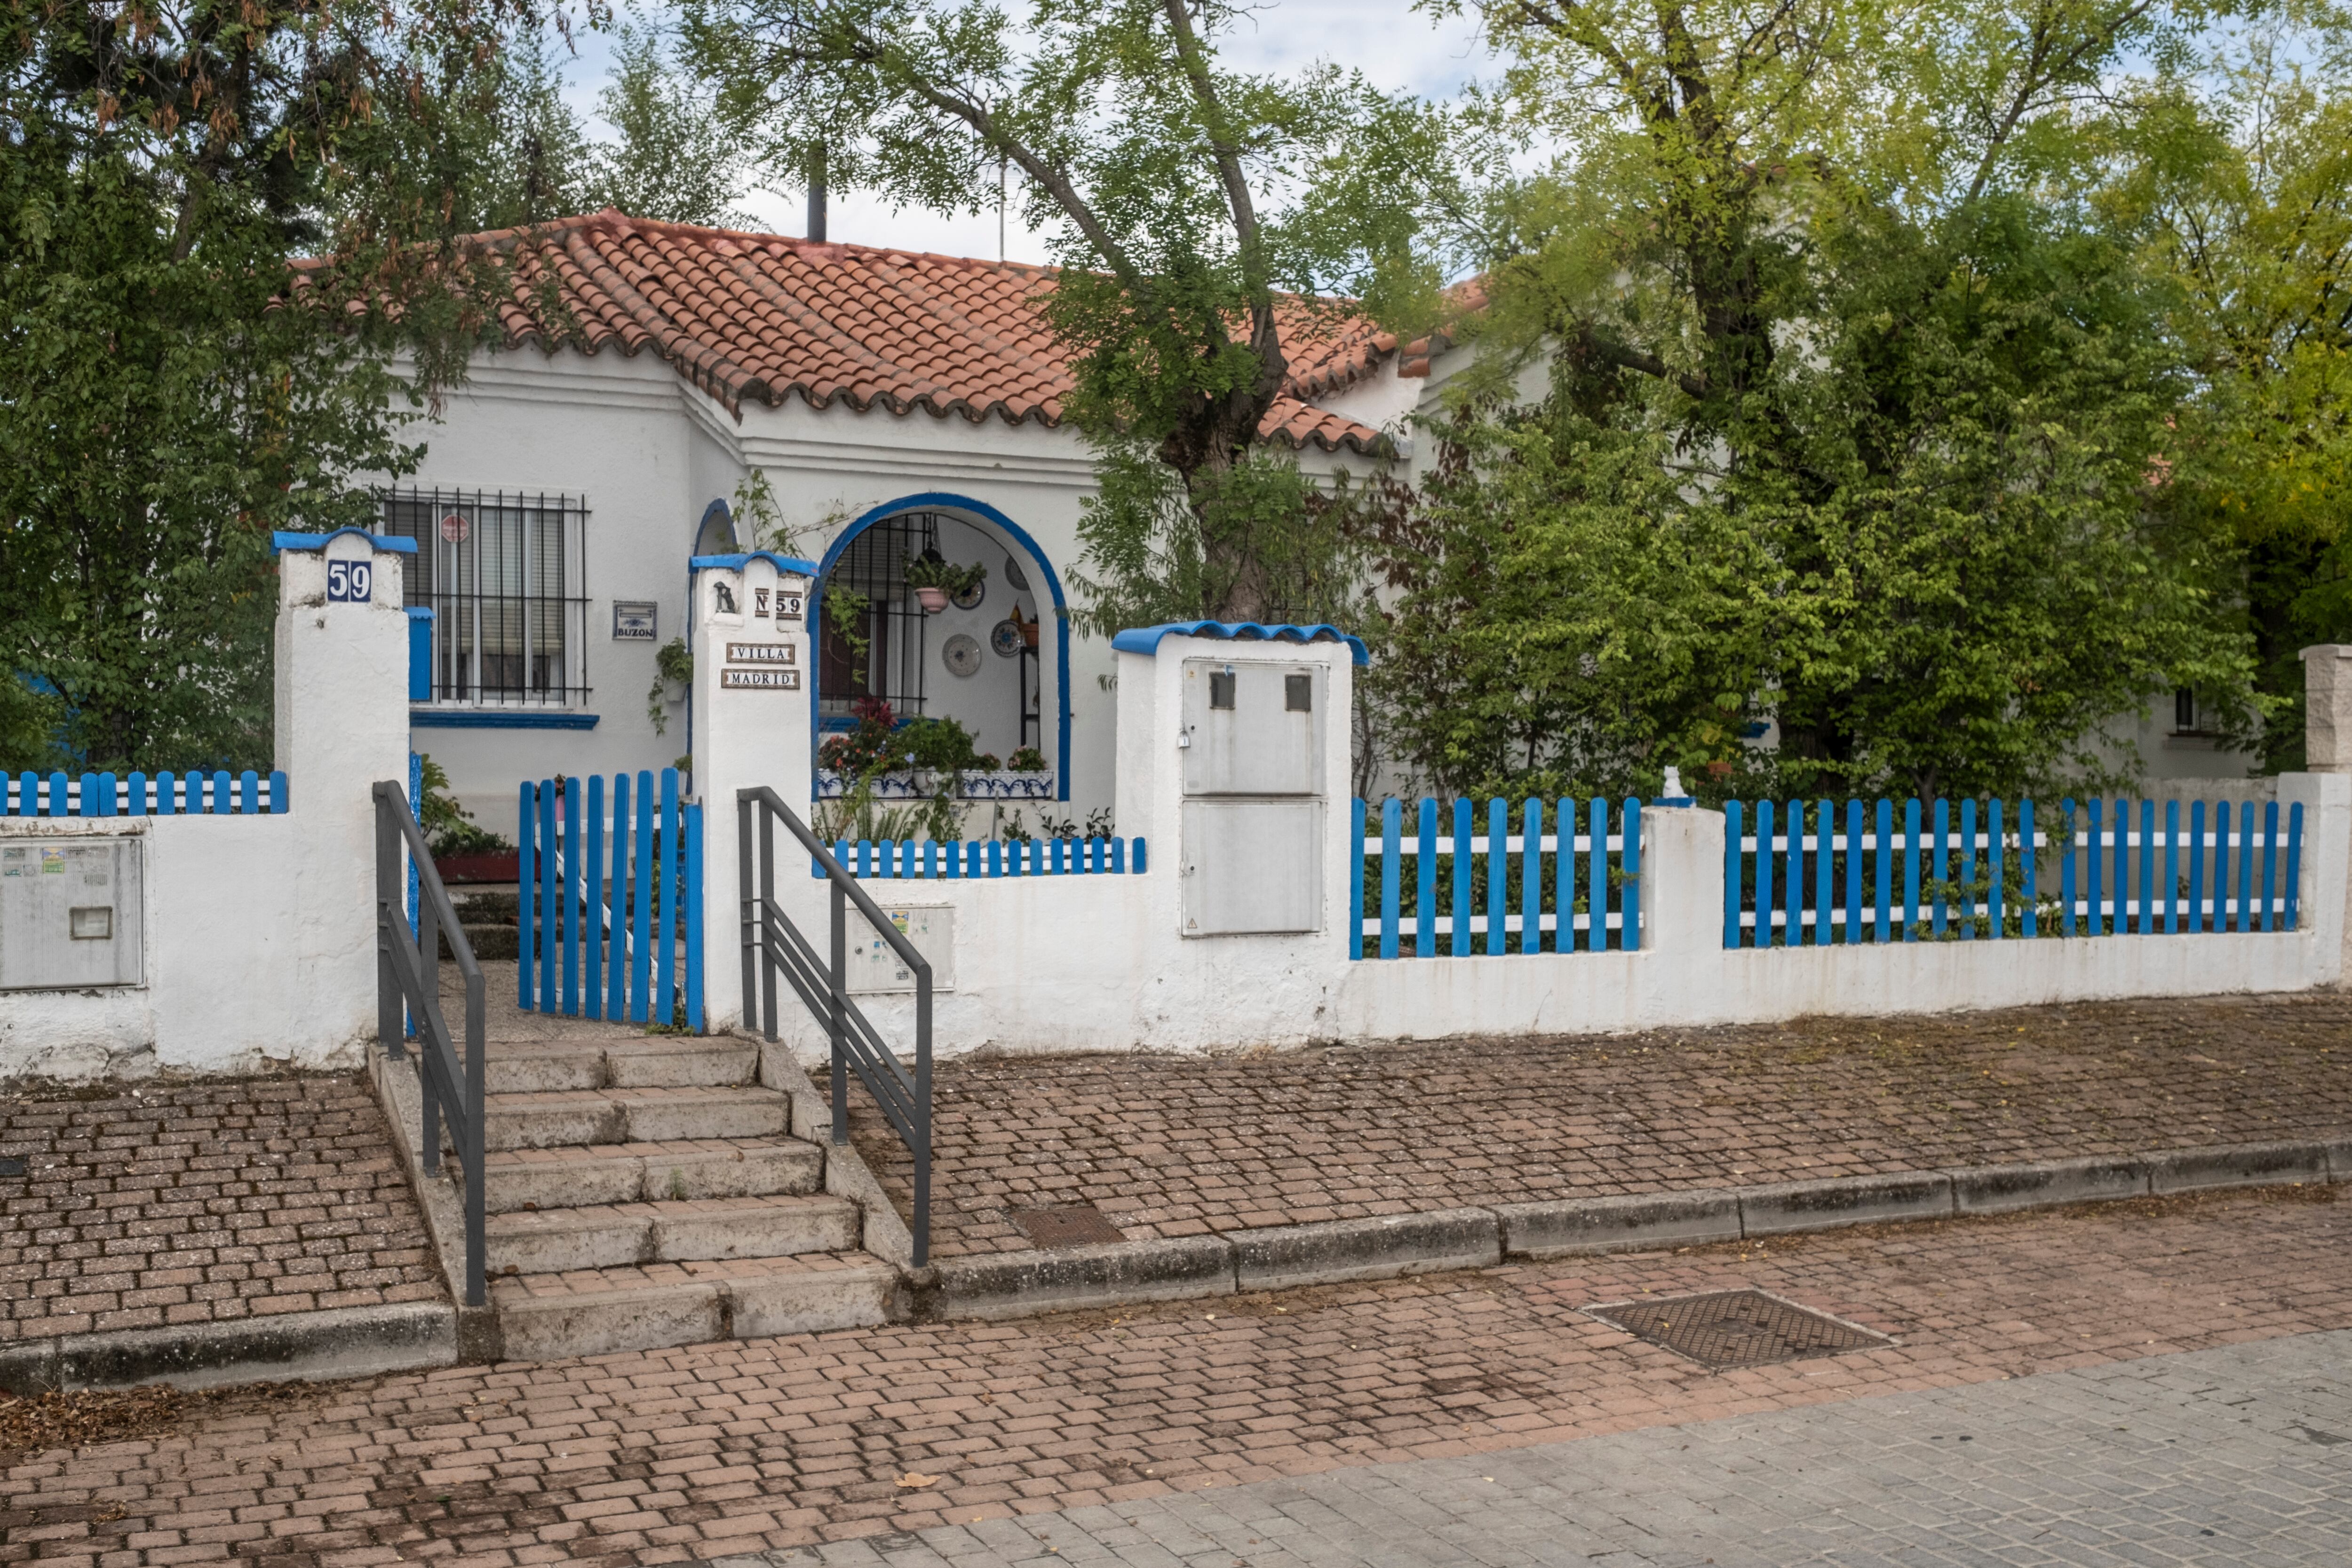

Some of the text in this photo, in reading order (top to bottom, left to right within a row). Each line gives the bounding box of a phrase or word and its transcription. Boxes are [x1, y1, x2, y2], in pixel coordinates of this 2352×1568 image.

[329, 564, 370, 598] 59
[776, 597, 801, 613] 59
[618, 628, 653, 637] BUZON
[738, 647, 785, 659] VILLA
[732, 673, 790, 685] MADRID
